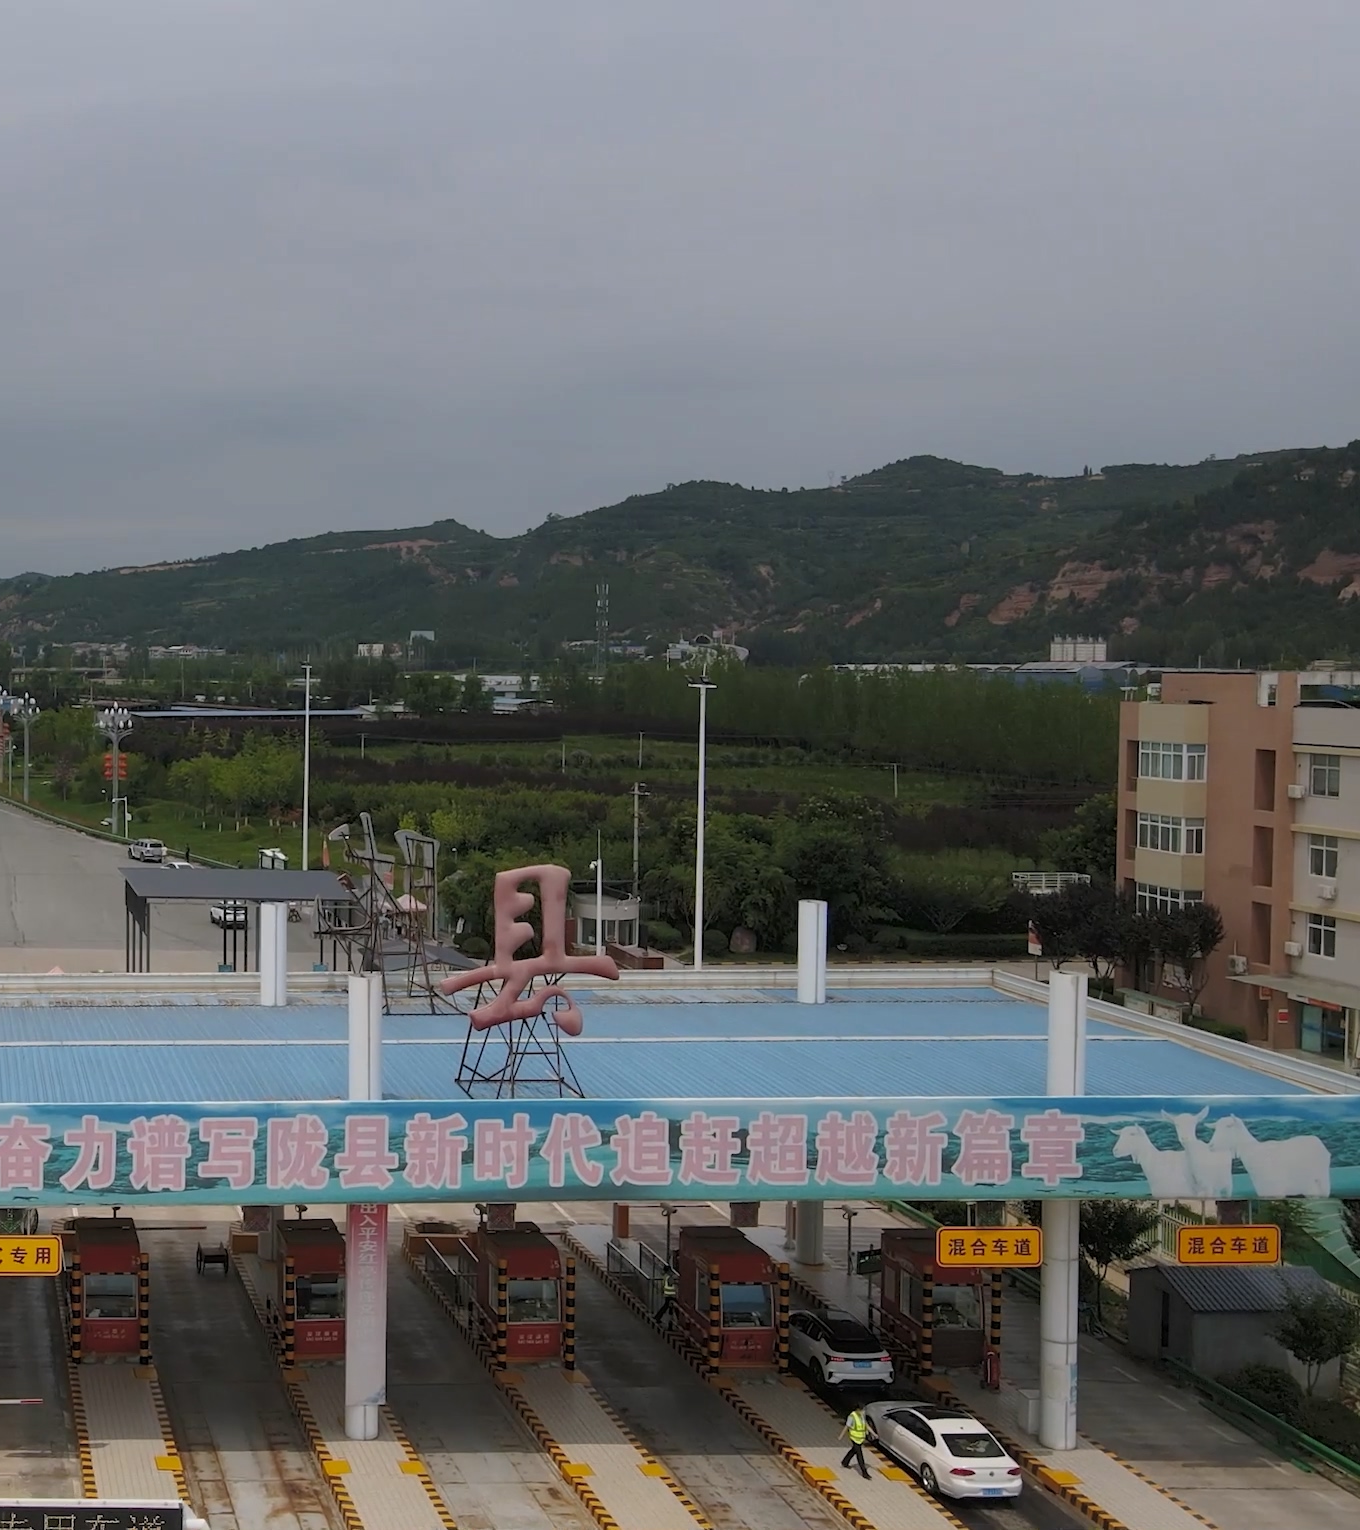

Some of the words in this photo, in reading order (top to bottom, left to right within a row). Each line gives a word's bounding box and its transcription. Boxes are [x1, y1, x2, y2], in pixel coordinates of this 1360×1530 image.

[948, 1237, 1032, 1257] 混合车道
[1188, 1236, 1269, 1255] 混合车道
[10, 1246, 51, 1265] 专用
